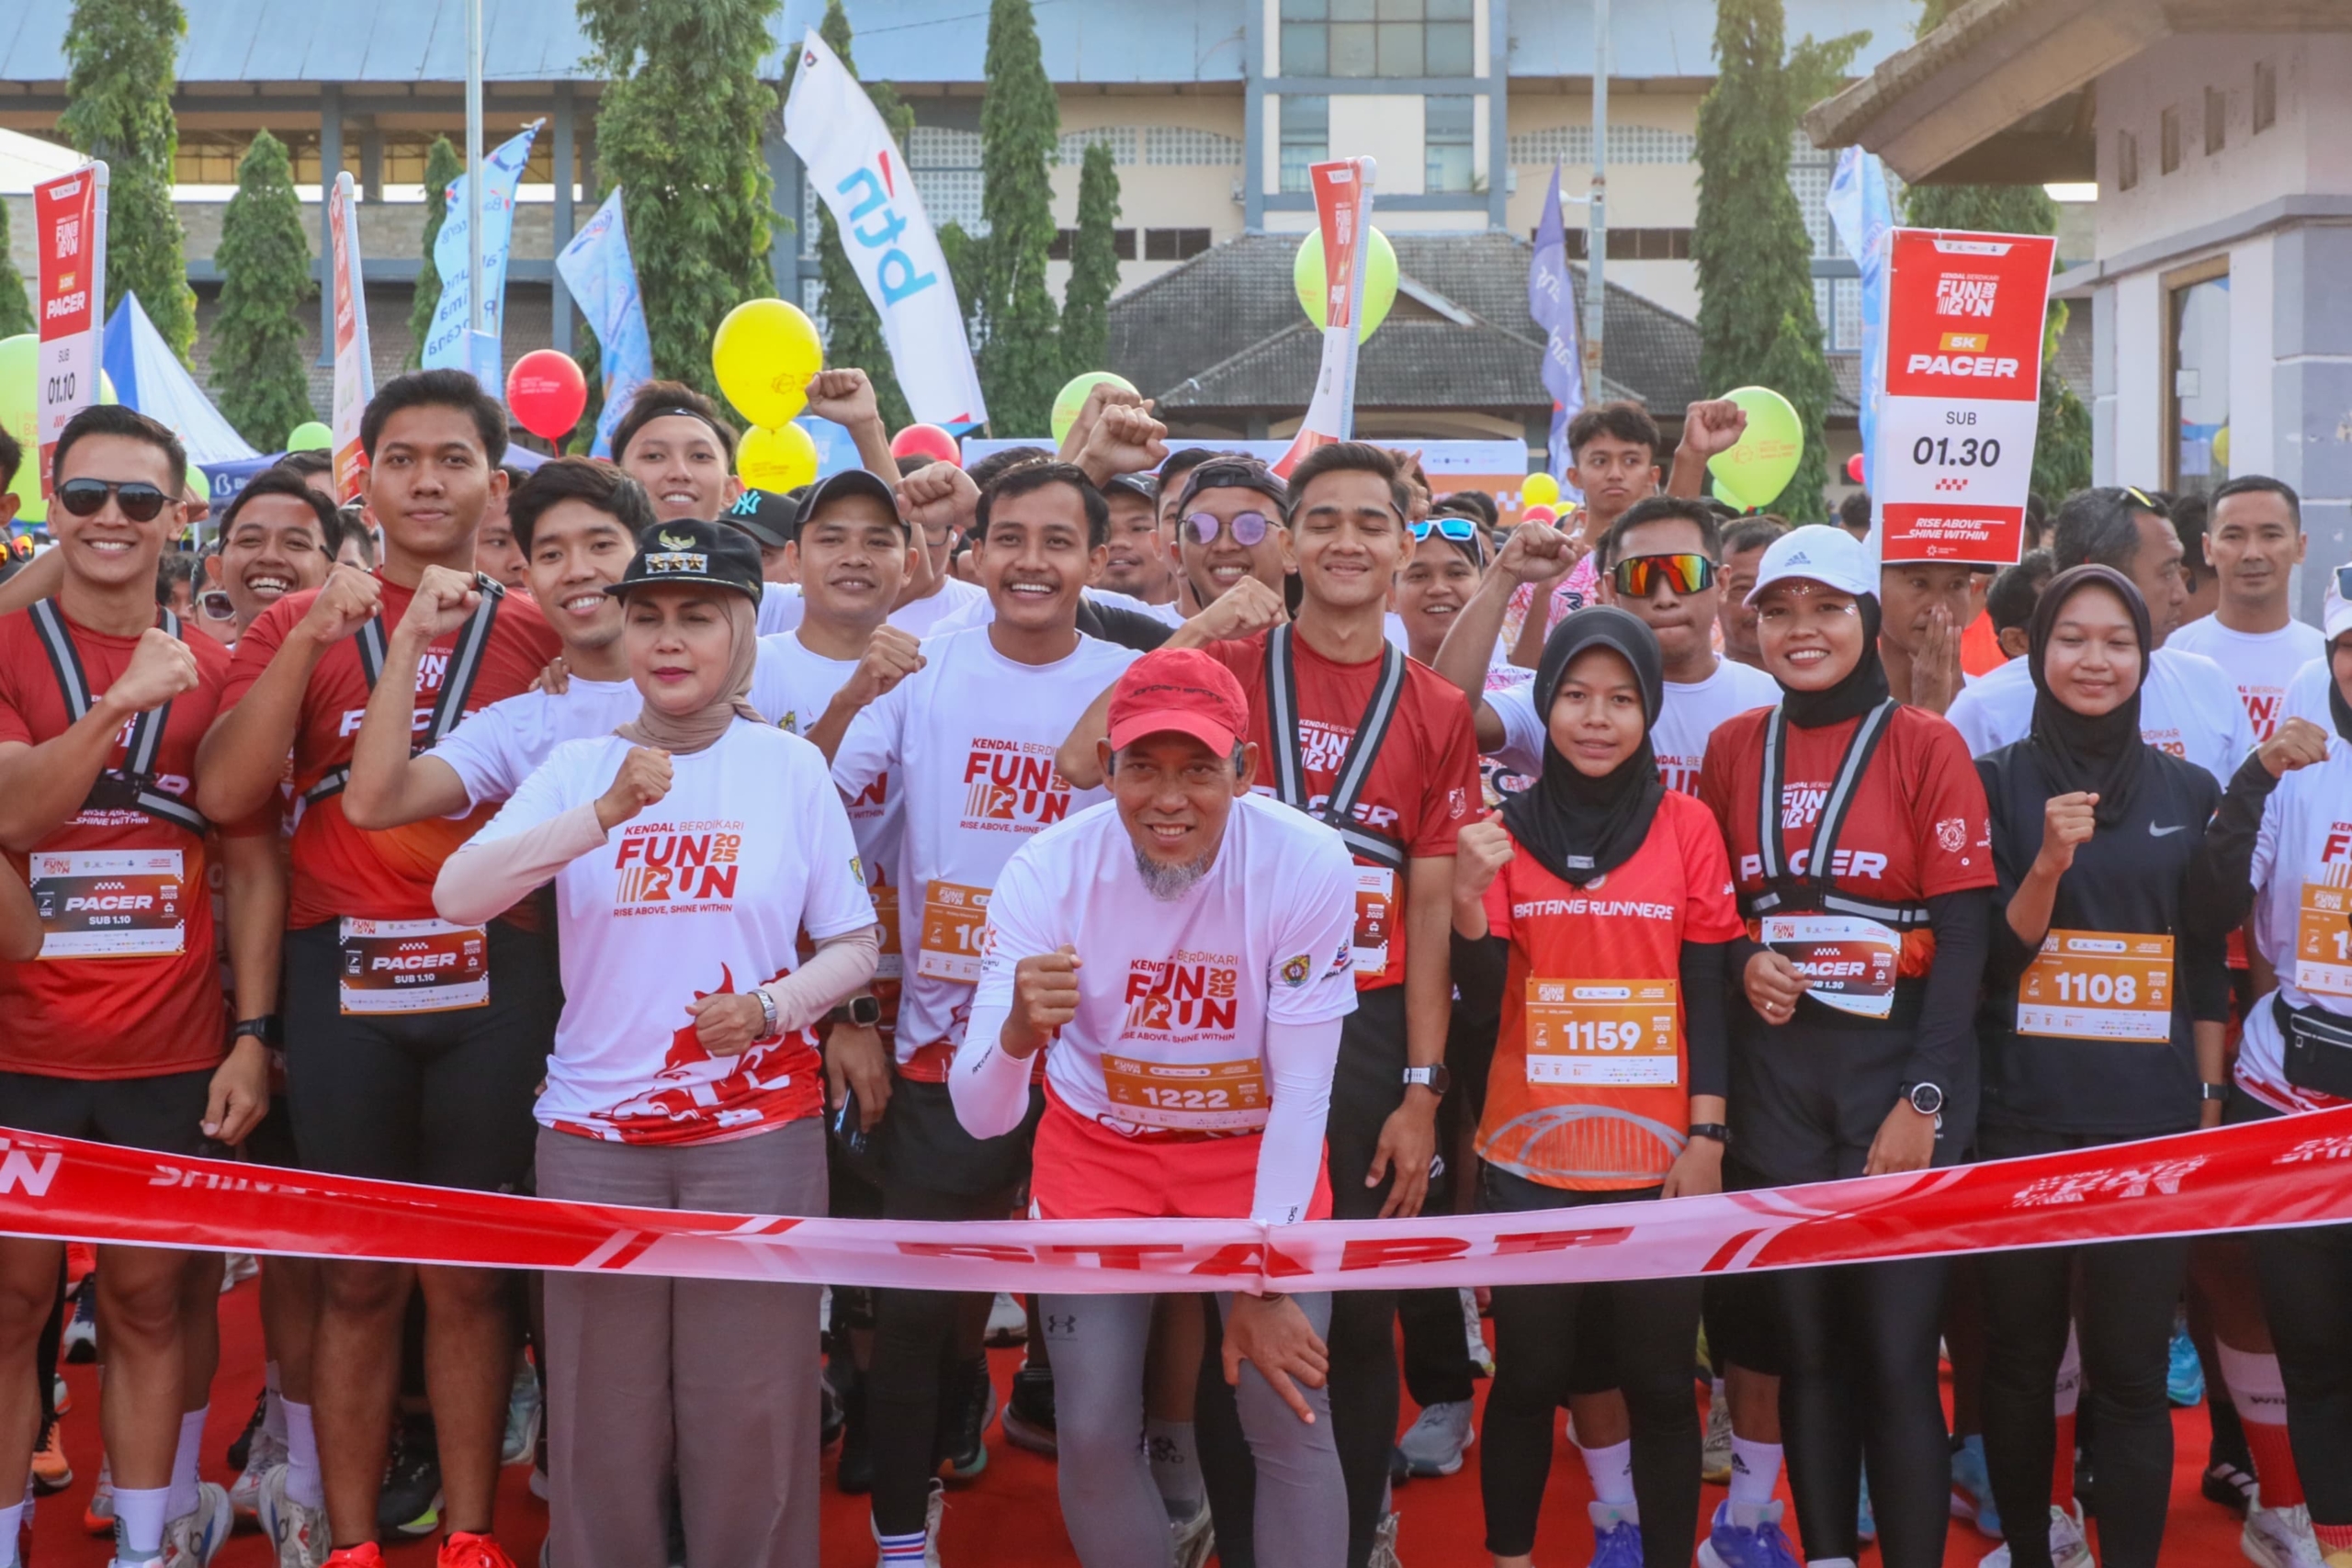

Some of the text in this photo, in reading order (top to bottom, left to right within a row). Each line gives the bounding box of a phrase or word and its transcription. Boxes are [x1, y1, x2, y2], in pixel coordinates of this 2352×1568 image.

[1936, 279, 1983, 299] FUN
[46, 290, 85, 320] PACER
[1945, 296, 1995, 317] RUN
[1951, 336, 1977, 348] 5K
[58, 348, 70, 362] SUB
[1906, 354, 2019, 378] PACER
[48, 372, 75, 405] 01.10
[1946, 412, 1977, 425] SUB
[1913, 436, 2001, 468] 01.30
[1916, 518, 1983, 529] RISE ABOVE
[1909, 529, 1989, 541] SHINE WITHIN
[1299, 719, 1329, 729] KENDAL
[971, 738, 1019, 752] KENDAL
[1298, 728, 1346, 757] FUN
[963, 751, 1052, 792] FUN
[983, 784, 1071, 825] RUN
[1782, 790, 1827, 809] FUN
[75, 817, 108, 826] SHINE
[625, 819, 745, 836] KENDAL BERDIKARI
[959, 820, 979, 829] RISE
[1013, 824, 1040, 834] SHINE
[715, 833, 741, 848] 20
[615, 834, 711, 869] FUN
[710, 848, 739, 863] 25
[639, 865, 739, 901] RUN
[64, 895, 153, 912] PACER
[614, 903, 732, 918] RISE ABOVE, SHINE WITHIN
[1514, 899, 1675, 921] BATANG RUNNERS
[88, 916, 131, 925] SUB 1.10
[371, 953, 458, 971] PACER
[1177, 949, 1238, 965] BERDIKARI
[1208, 967, 1238, 984] 20
[1792, 962, 1865, 976] PACER
[394, 974, 435, 984] SUB 1.10
[1125, 963, 1205, 1005] FUN
[1825, 981, 1844, 989] 1.30
[1207, 982, 1237, 998] 25
[2055, 972, 2136, 1004] 1108
[1142, 994, 1238, 1031] RUN
[1172, 1033, 1200, 1043] SHINE
[1202, 1032, 1236, 1042] WITHIN
[1563, 1021, 1642, 1051] 1159
[1141, 1087, 1230, 1109] 1222
